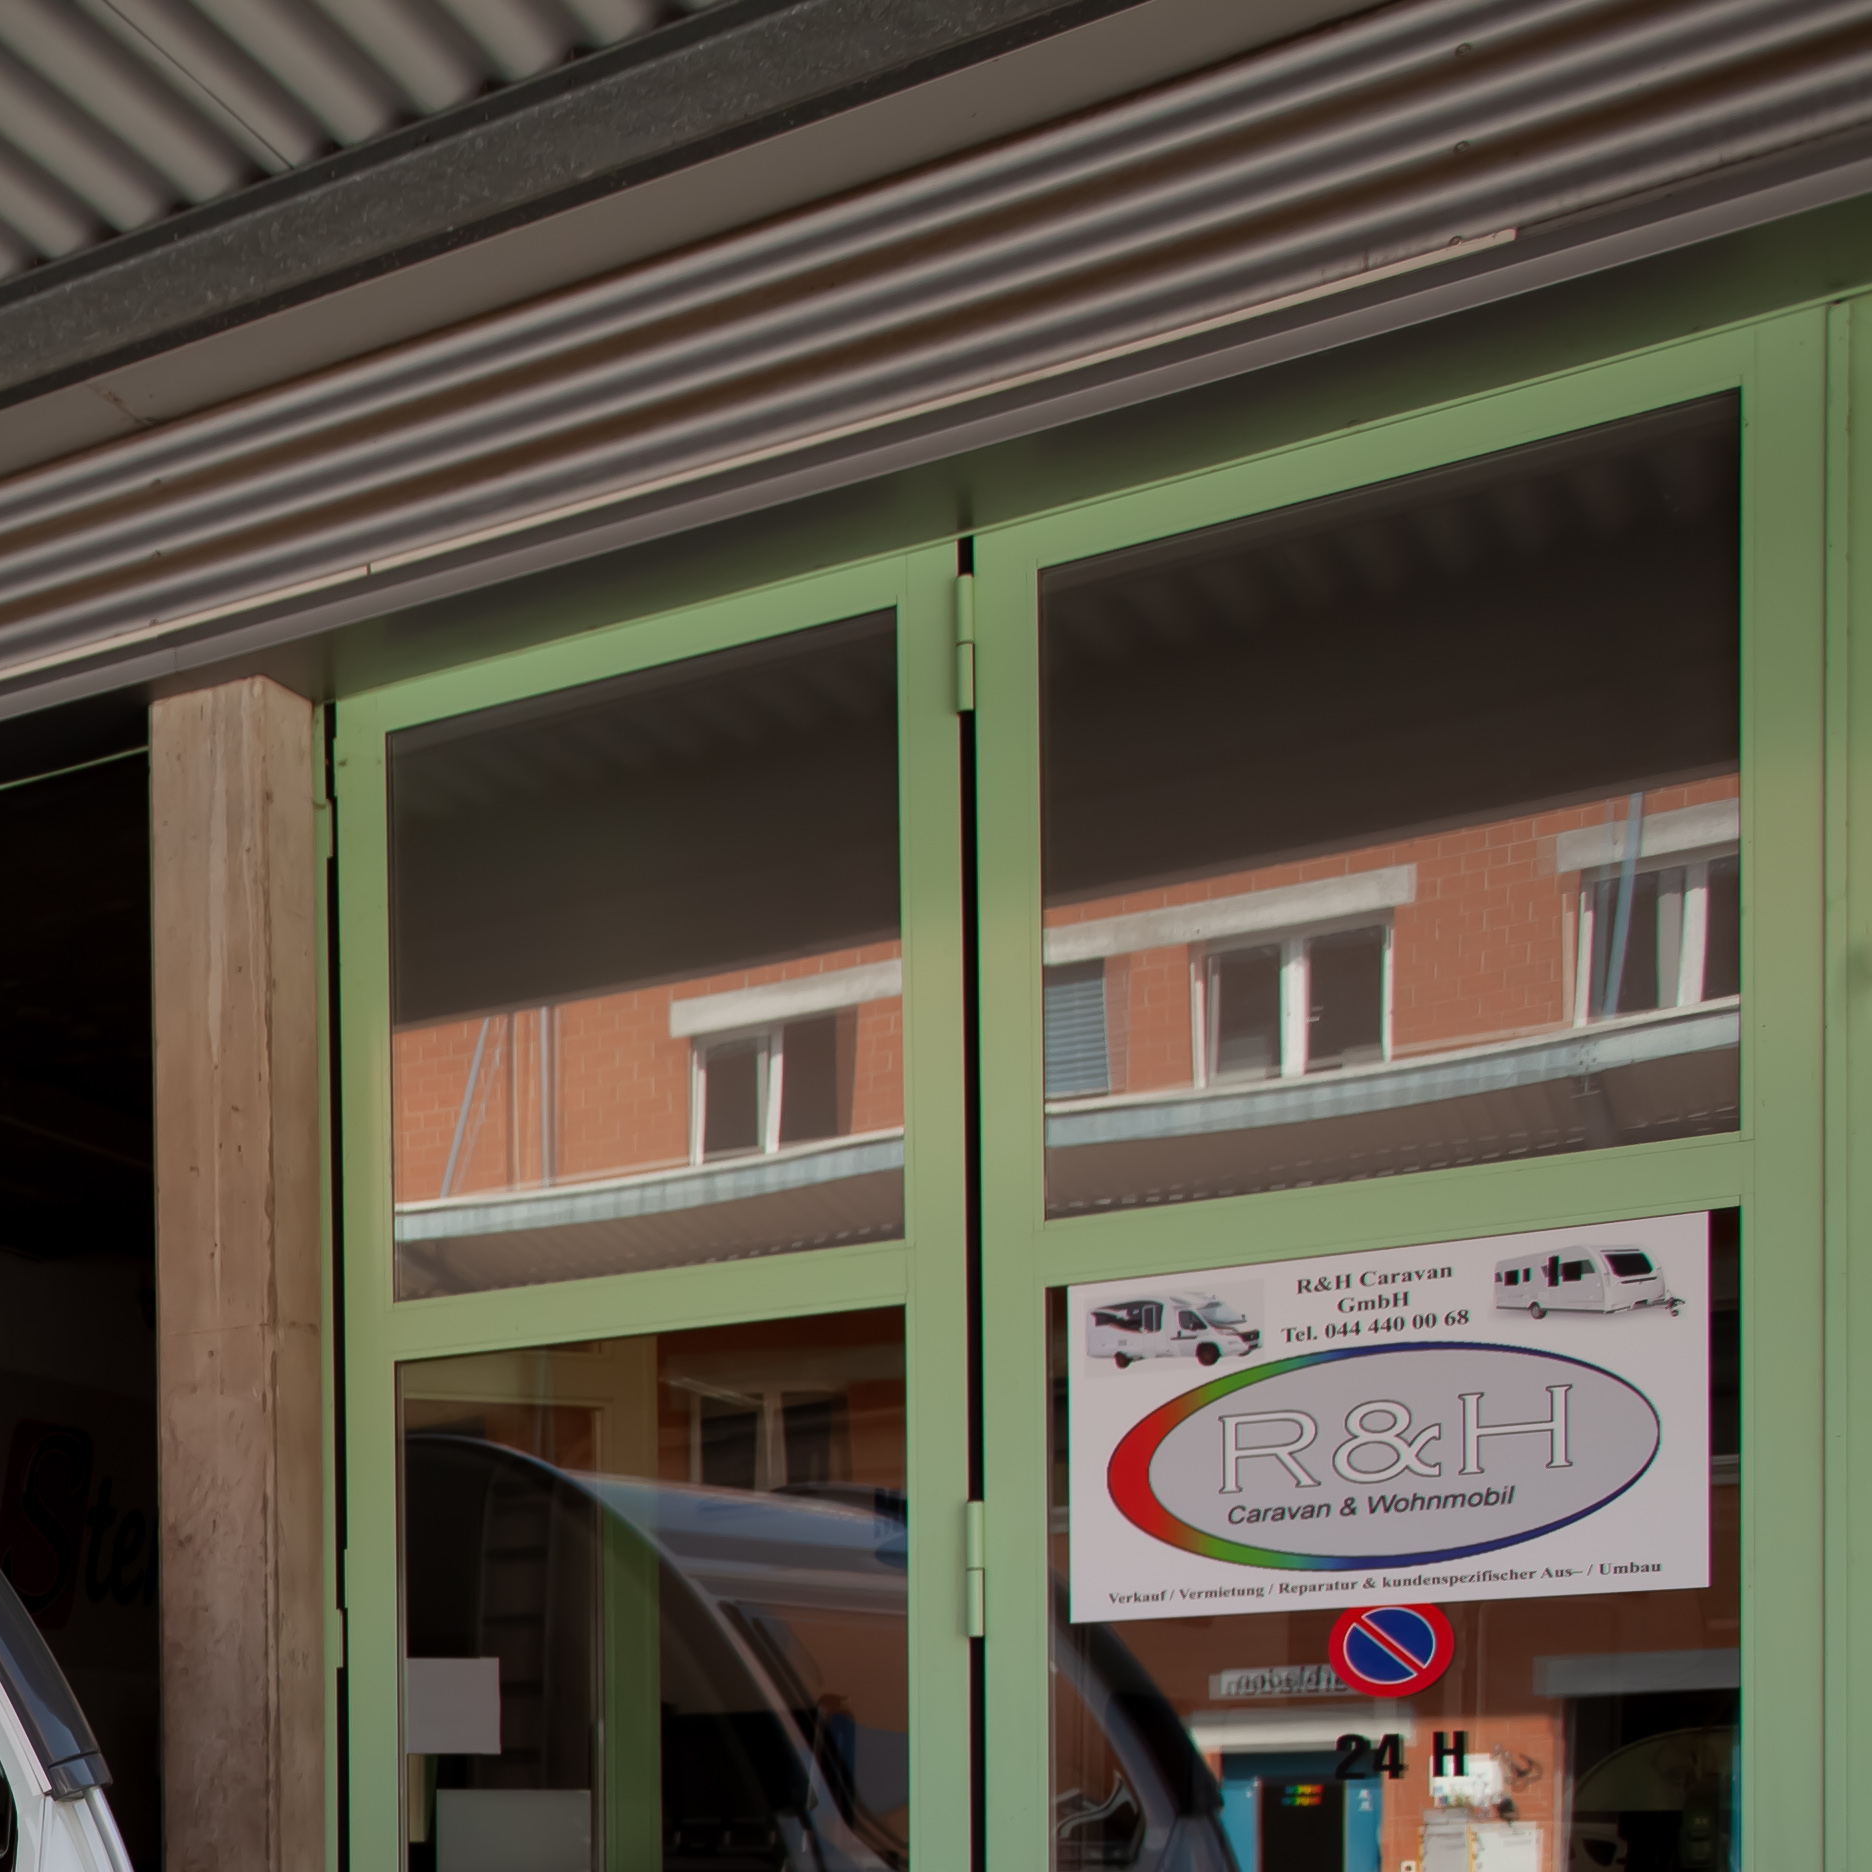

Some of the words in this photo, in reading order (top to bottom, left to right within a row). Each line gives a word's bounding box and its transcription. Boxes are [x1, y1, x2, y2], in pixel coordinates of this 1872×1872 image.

[1296, 1273, 1352, 1295] R&H
[1359, 1266, 1454, 1288] Caravan
[1337, 1291, 1410, 1314] GmbH
[1280, 1325, 1318, 1344] Tel.
[1324, 1320, 1362, 1339] 044
[1367, 1316, 1406, 1334] 440
[1412, 1313, 1438, 1330] 00
[1444, 1309, 1471, 1327] 68
[1217, 1383, 1574, 1494] R&H
[1227, 1501, 1332, 1525] Caravan
[1339, 1496, 1357, 1517] &
[1367, 1484, 1516, 1515] Wohnmobil
[1108, 1589, 1166, 1605] Verkauf
[1178, 1584, 1265, 1601] Vermietung
[1278, 1579, 1359, 1597] Reparatur
[1362, 1576, 1377, 1589] &
[1382, 1568, 1537, 1589] kundenspezifischer
[1598, 1560, 1663, 1576] Umbau
[1335, 1733, 1405, 1780] 24
[1432, 1730, 1466, 1777] H
